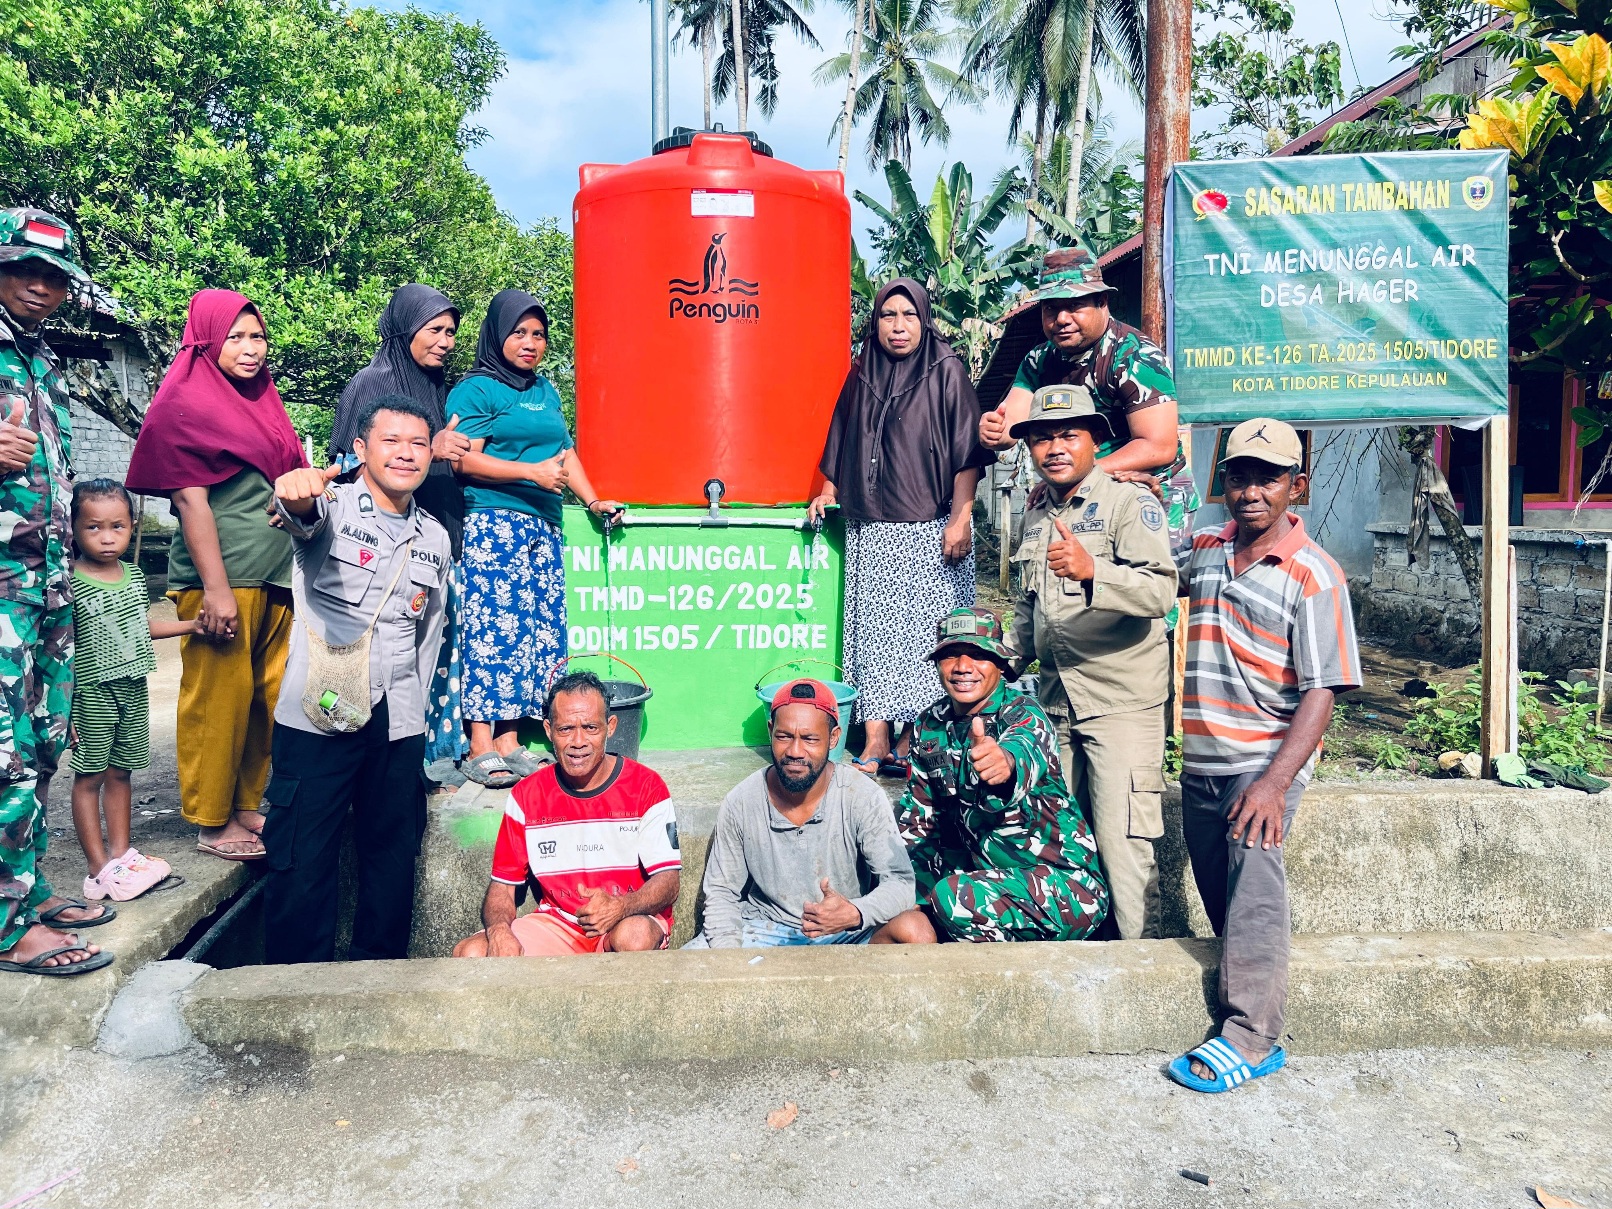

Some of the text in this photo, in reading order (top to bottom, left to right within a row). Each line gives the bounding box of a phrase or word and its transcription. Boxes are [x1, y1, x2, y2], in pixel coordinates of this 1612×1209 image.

[1244, 179, 1450, 218] SASARAN TAMBAHAN
[1203, 252, 1251, 276] TNI
[1263, 245, 1419, 274] MENUNGGAL
[1431, 243, 1477, 267] AIR
[1260, 278, 1419, 308] DESA HAGER
[669, 297, 760, 323] Penguin
[1183, 338, 1498, 369] TMMD KE-126 TA.2025 1505/TIDORE
[1232, 371, 1448, 393] KOTA TIDORE KEPULAUAN
[340, 523, 379, 548] M.ALTING
[1072, 521, 1102, 532] POL-PP
[410, 548, 441, 567] POLRI
[564, 544, 830, 572] NI MANUNGGAL AIR
[567, 625, 628, 651] ODIM
[633, 624, 700, 650] 1505
[731, 623, 827, 650] TIDORE
[950, 619, 973, 630] 1505
